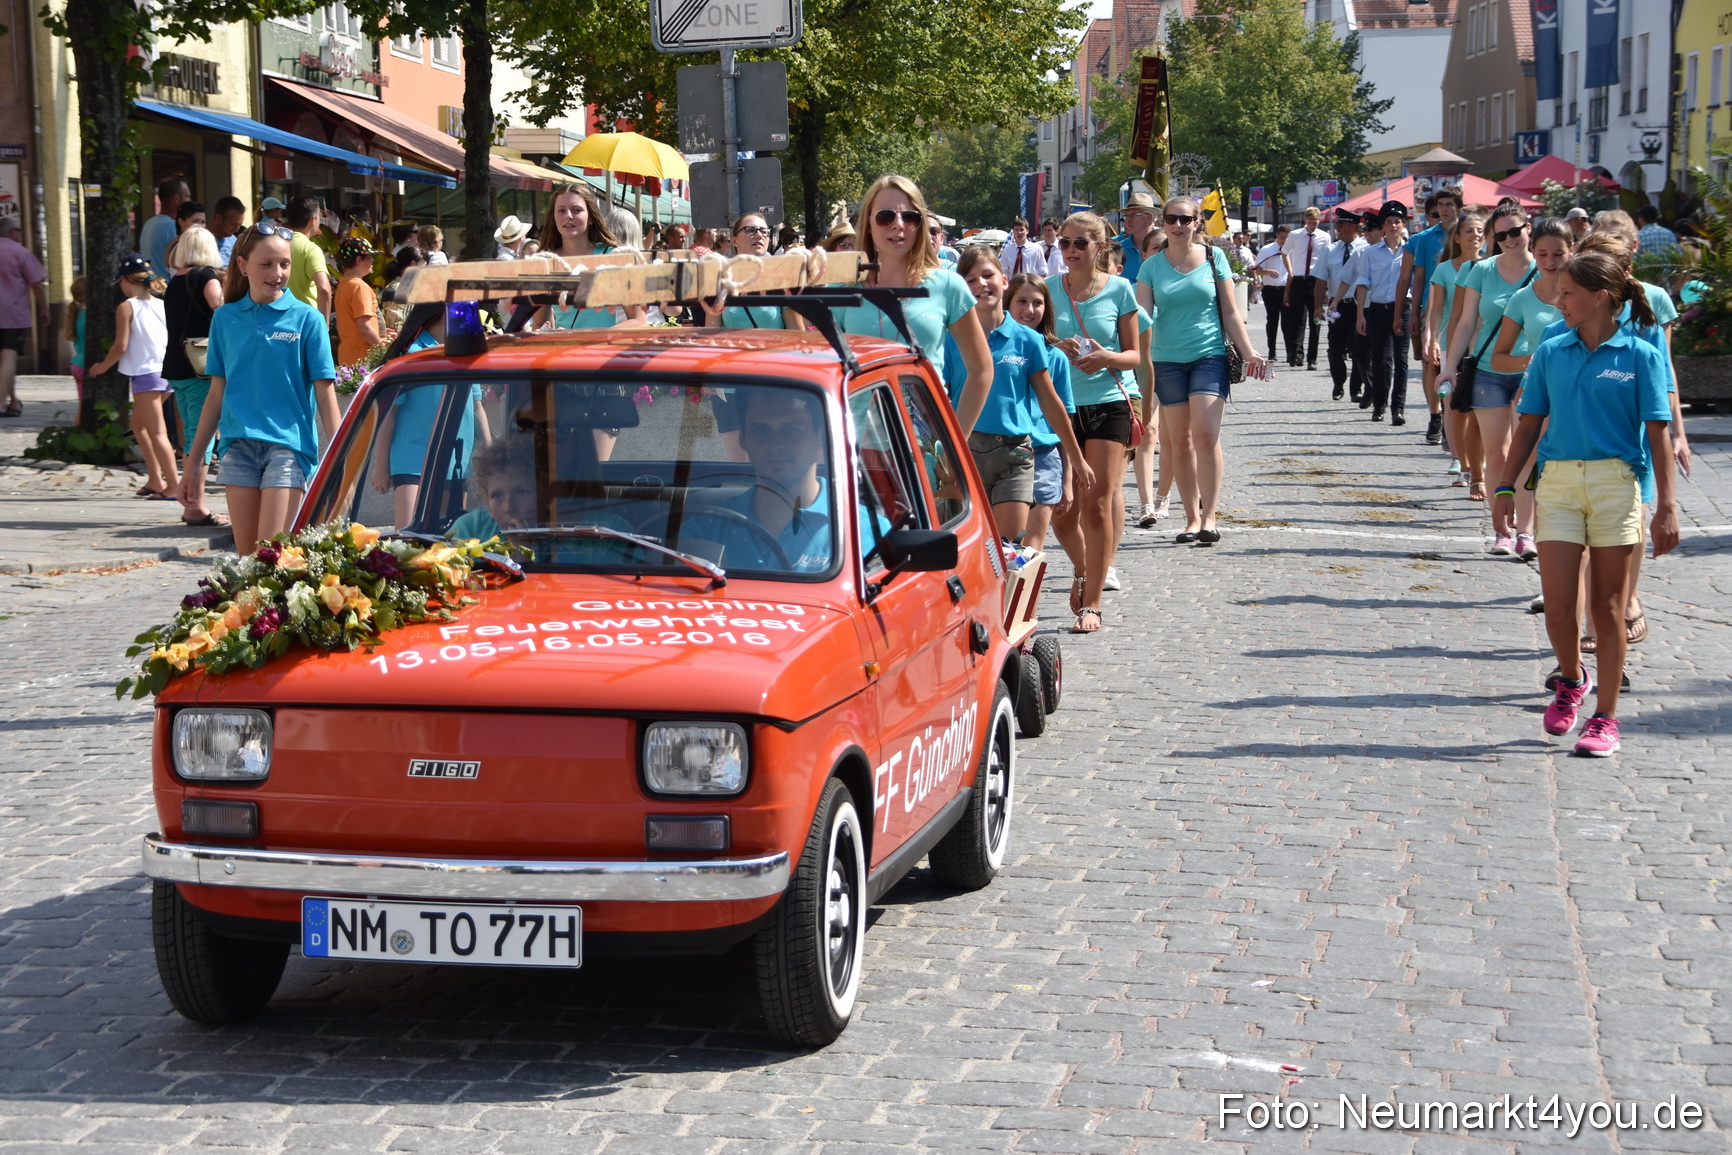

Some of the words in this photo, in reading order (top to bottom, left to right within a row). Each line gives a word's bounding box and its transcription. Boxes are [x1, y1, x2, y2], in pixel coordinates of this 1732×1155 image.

[693, 3, 758, 28] ZONE
[572, 599, 806, 615] Günching
[439, 614, 806, 641] Feuerwehrfest
[370, 631, 771, 675] 13.05-16.05.2016
[904, 697, 978, 813] Günching
[411, 761, 476, 777] FIGO
[311, 933, 321, 946] D
[331, 907, 387, 952] NM
